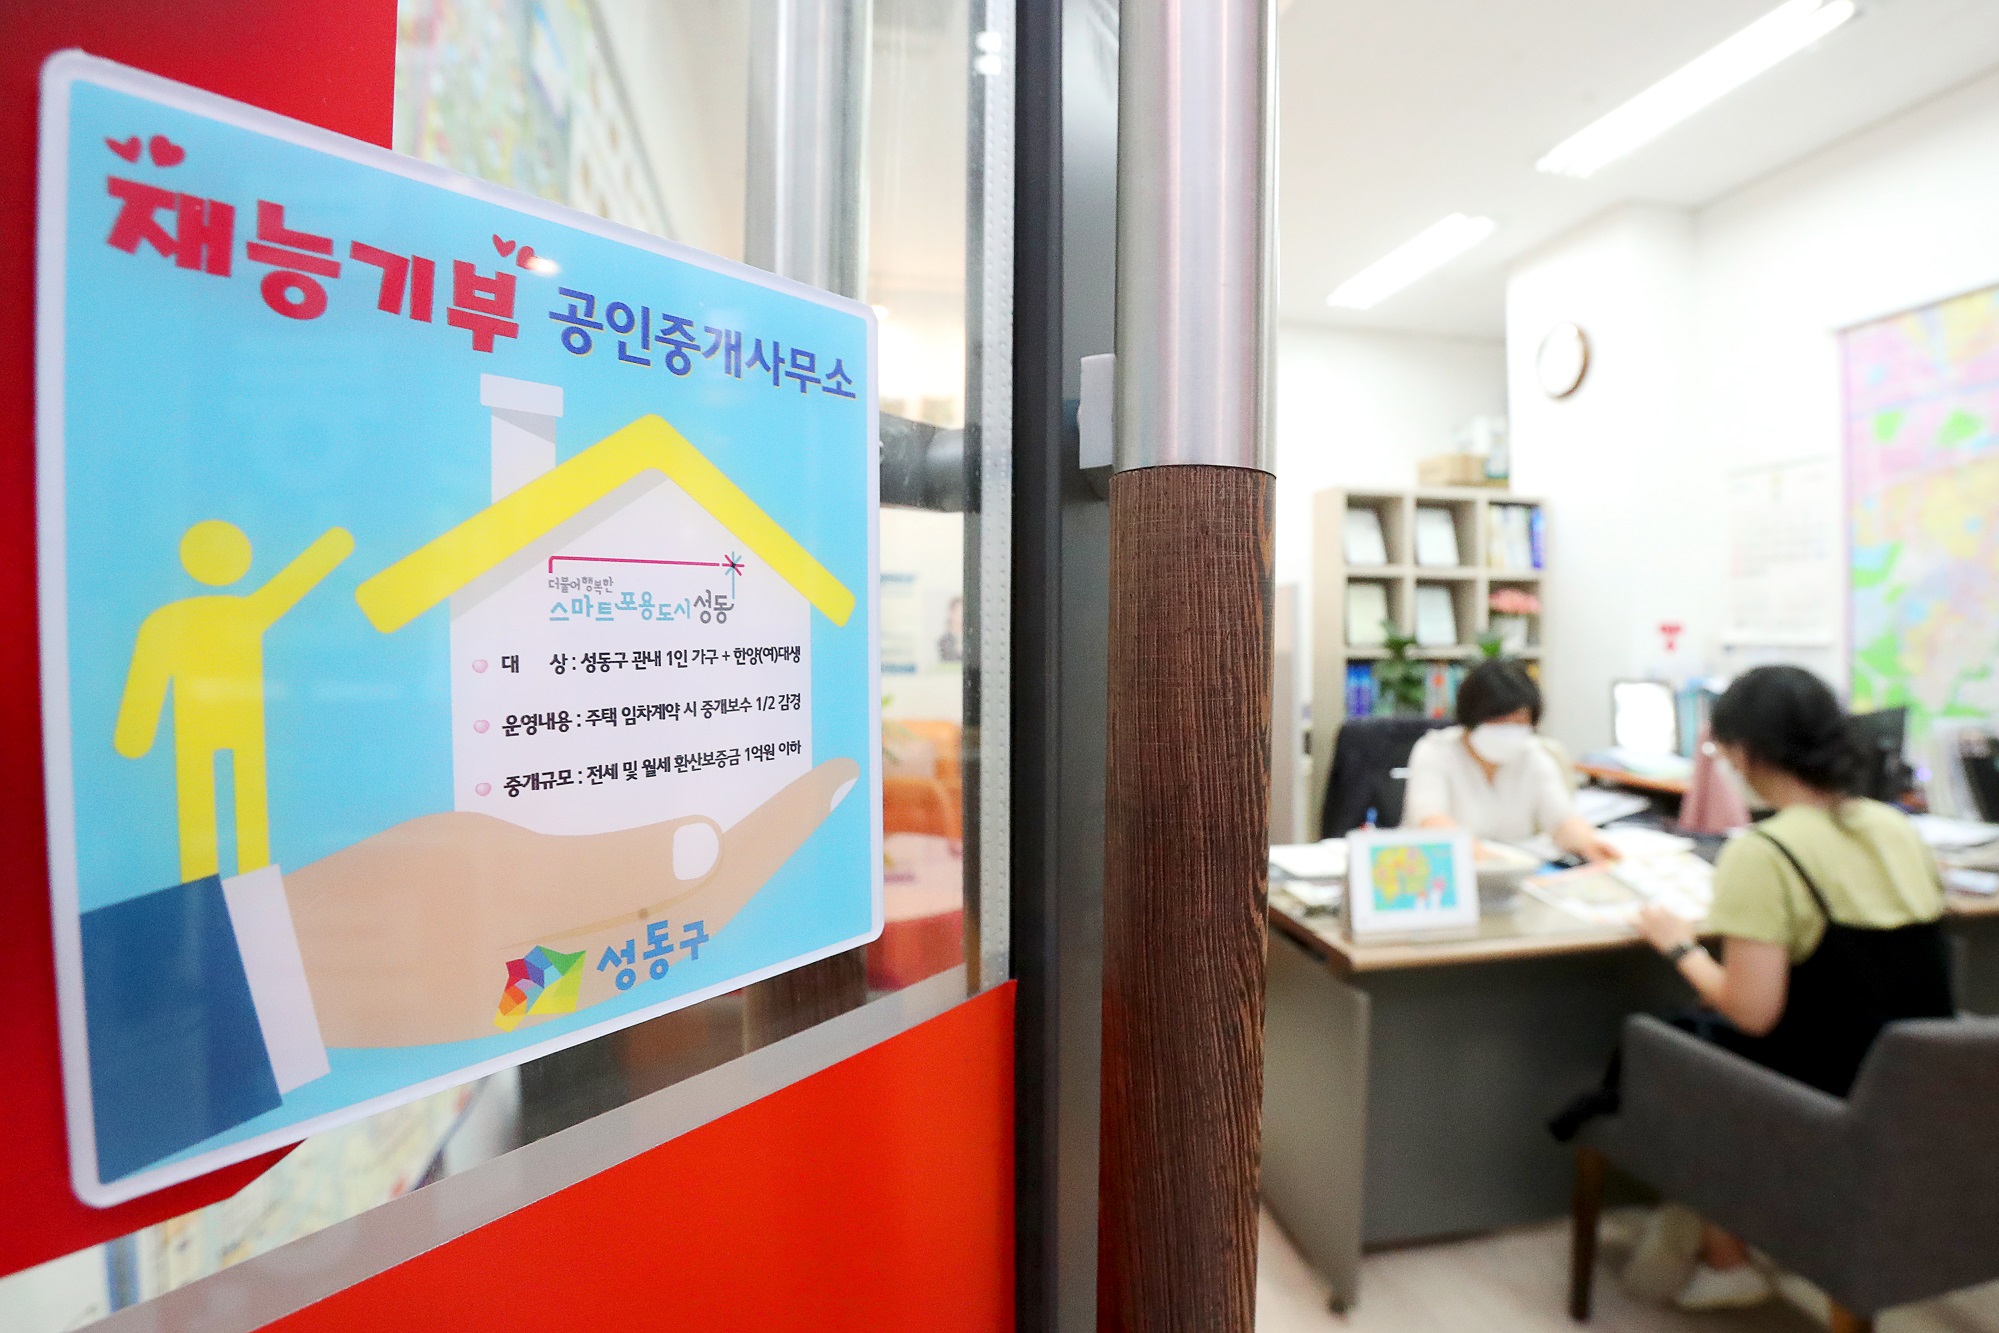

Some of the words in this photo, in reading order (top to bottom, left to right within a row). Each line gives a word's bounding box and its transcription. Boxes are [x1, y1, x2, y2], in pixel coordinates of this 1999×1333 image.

[105, 174, 520, 354] 재능기부
[548, 286, 858, 400] 공인중개사무소
[549, 591, 691, 622] 스마트포용도시
[693, 589, 735, 624] 성동
[501, 654, 520, 674] 대
[580, 651, 628, 674] 성동구
[631, 649, 662, 671] 관내
[666, 649, 688, 668] 1인
[691, 648, 719, 666] 가구
[733, 645, 801, 665] 한양(여)대생
[501, 710, 572, 737] 운영내용
[585, 706, 618, 727] 주택
[621, 702, 680, 726] 임차계약
[683, 701, 697, 717] 시
[700, 697, 752, 719] 중개보수
[756, 695, 776, 712] 1/2
[778, 692, 801, 711] 감경
[503, 769, 574, 798] 중개규모
[586, 762, 618, 786] 전세
[622, 758, 638, 781] 및
[641, 757, 671, 778] 월세
[673, 748, 741, 774] 환산보증금
[744, 743, 775, 763] 1억원
[778, 740, 801, 757] 이하
[597, 920, 709, 990] 성동구
